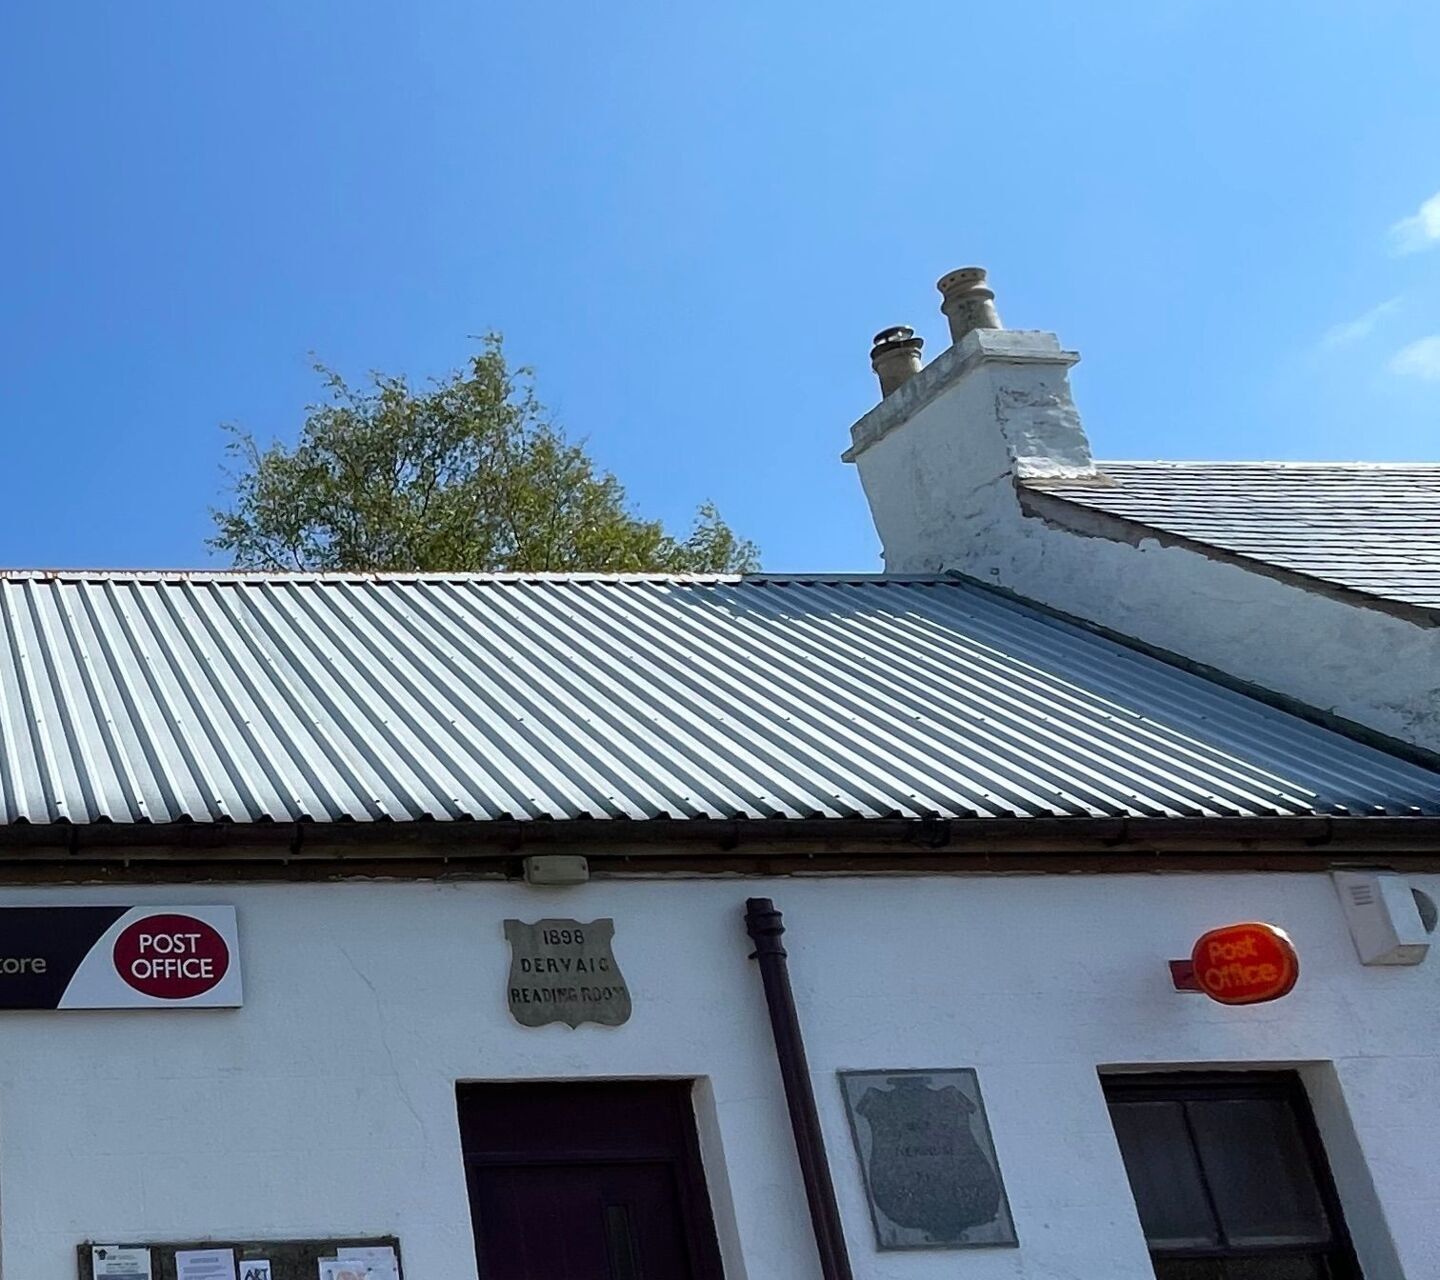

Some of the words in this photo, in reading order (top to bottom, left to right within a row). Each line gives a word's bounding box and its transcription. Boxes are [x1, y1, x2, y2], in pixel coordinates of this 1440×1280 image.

[139, 933, 201, 953] POST
[543, 929, 585, 945] 1898
[1208, 935, 1258, 964] Post
[131, 958, 214, 979] OFFICE
[521, 957, 609, 973] DERVAIG
[1204, 964, 1278, 990] Office
